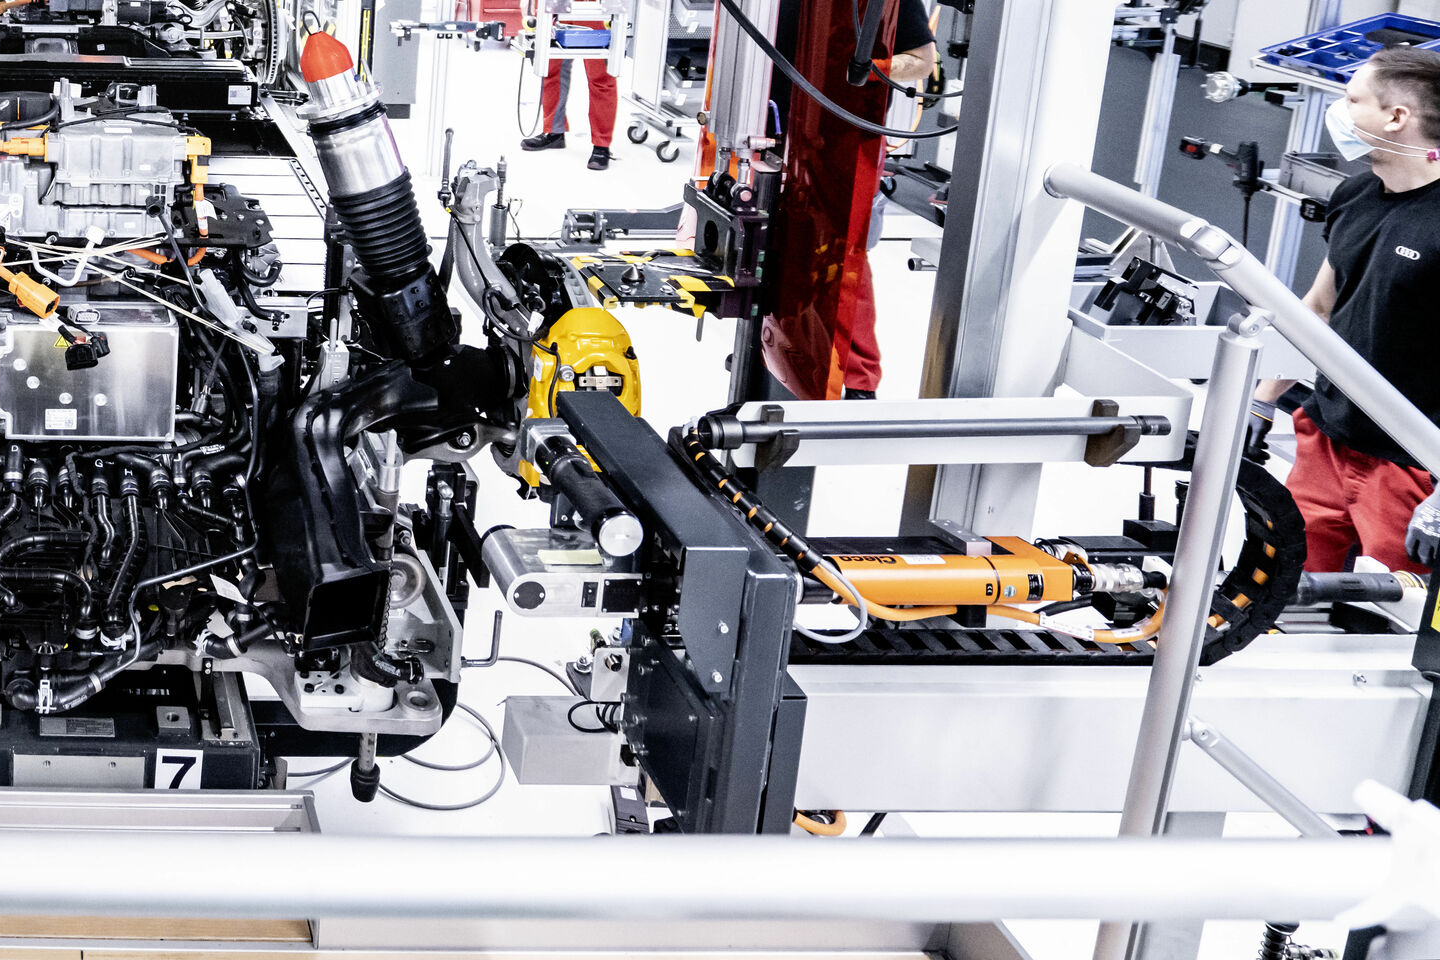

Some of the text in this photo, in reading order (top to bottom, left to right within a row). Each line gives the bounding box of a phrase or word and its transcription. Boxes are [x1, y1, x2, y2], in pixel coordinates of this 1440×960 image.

[11, 444, 19, 452] D
[94, 458, 104, 468] G
[124, 468, 133, 476] H
[161, 756, 197, 789] 7
